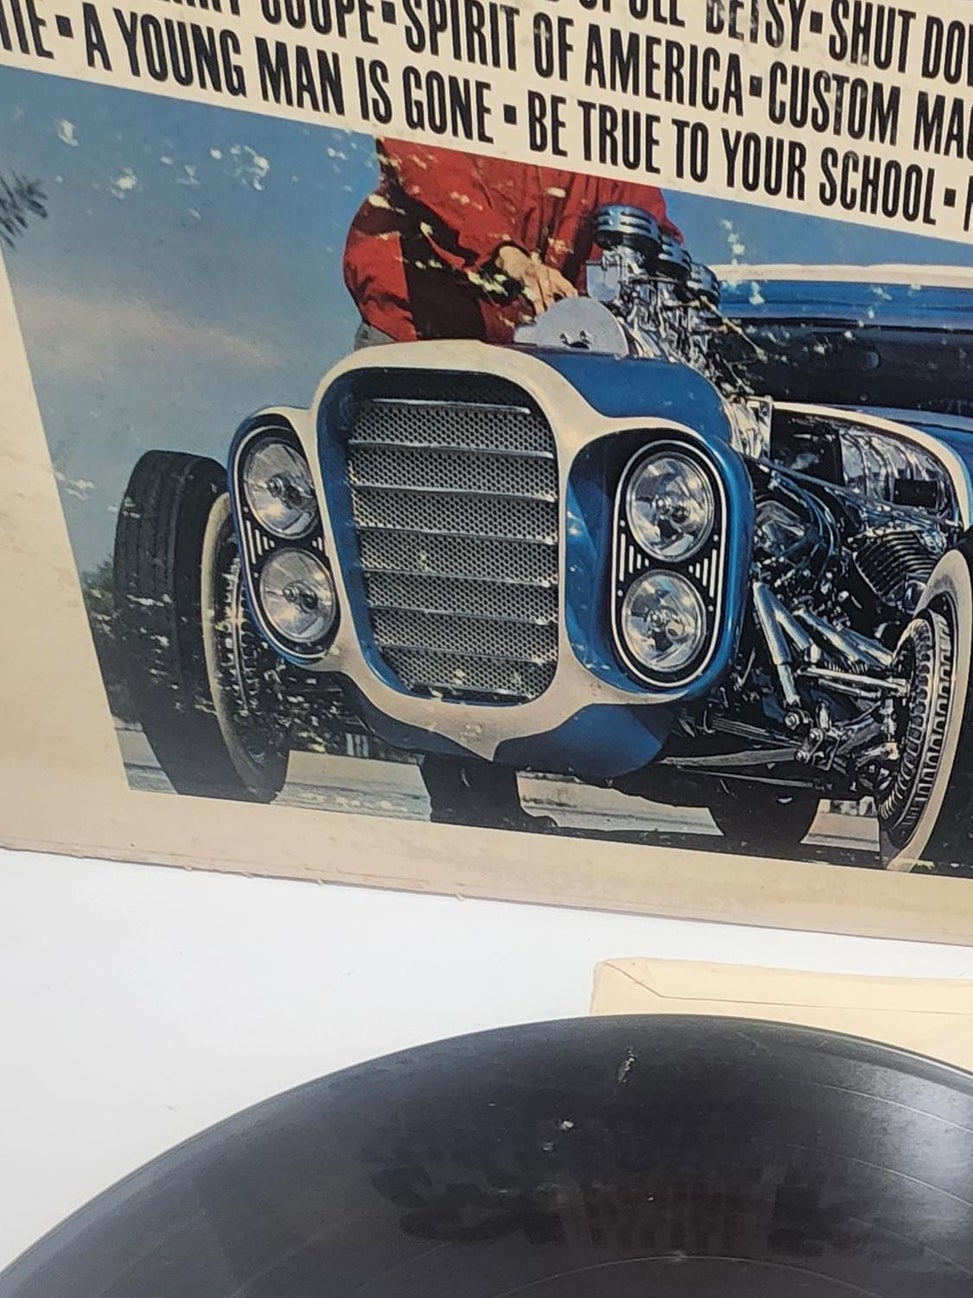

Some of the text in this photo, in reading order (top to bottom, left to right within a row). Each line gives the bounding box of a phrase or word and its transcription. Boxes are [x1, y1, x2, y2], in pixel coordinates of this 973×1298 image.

[404, 0, 520, 71] SPIRIT
[532, 12, 574, 82] OF
[584, 24, 744, 116] AMERICA
[768, 61, 901, 147] CUSTOM
[829, 0, 916, 73] SHUT
[82, 1, 113, 72] A
[112, 7, 248, 99] YOUNG
[254, 36, 346, 117] MAN
[355, 56, 393, 125] IS
[402, 65, 494, 145] GONE
[527, 90, 568, 158] BE
[577, 100, 661, 175] TRUE
[671, 118, 709, 184] TO
[721, 128, 807, 201] YOUR
[819, 147, 937, 226] SCHOOL
